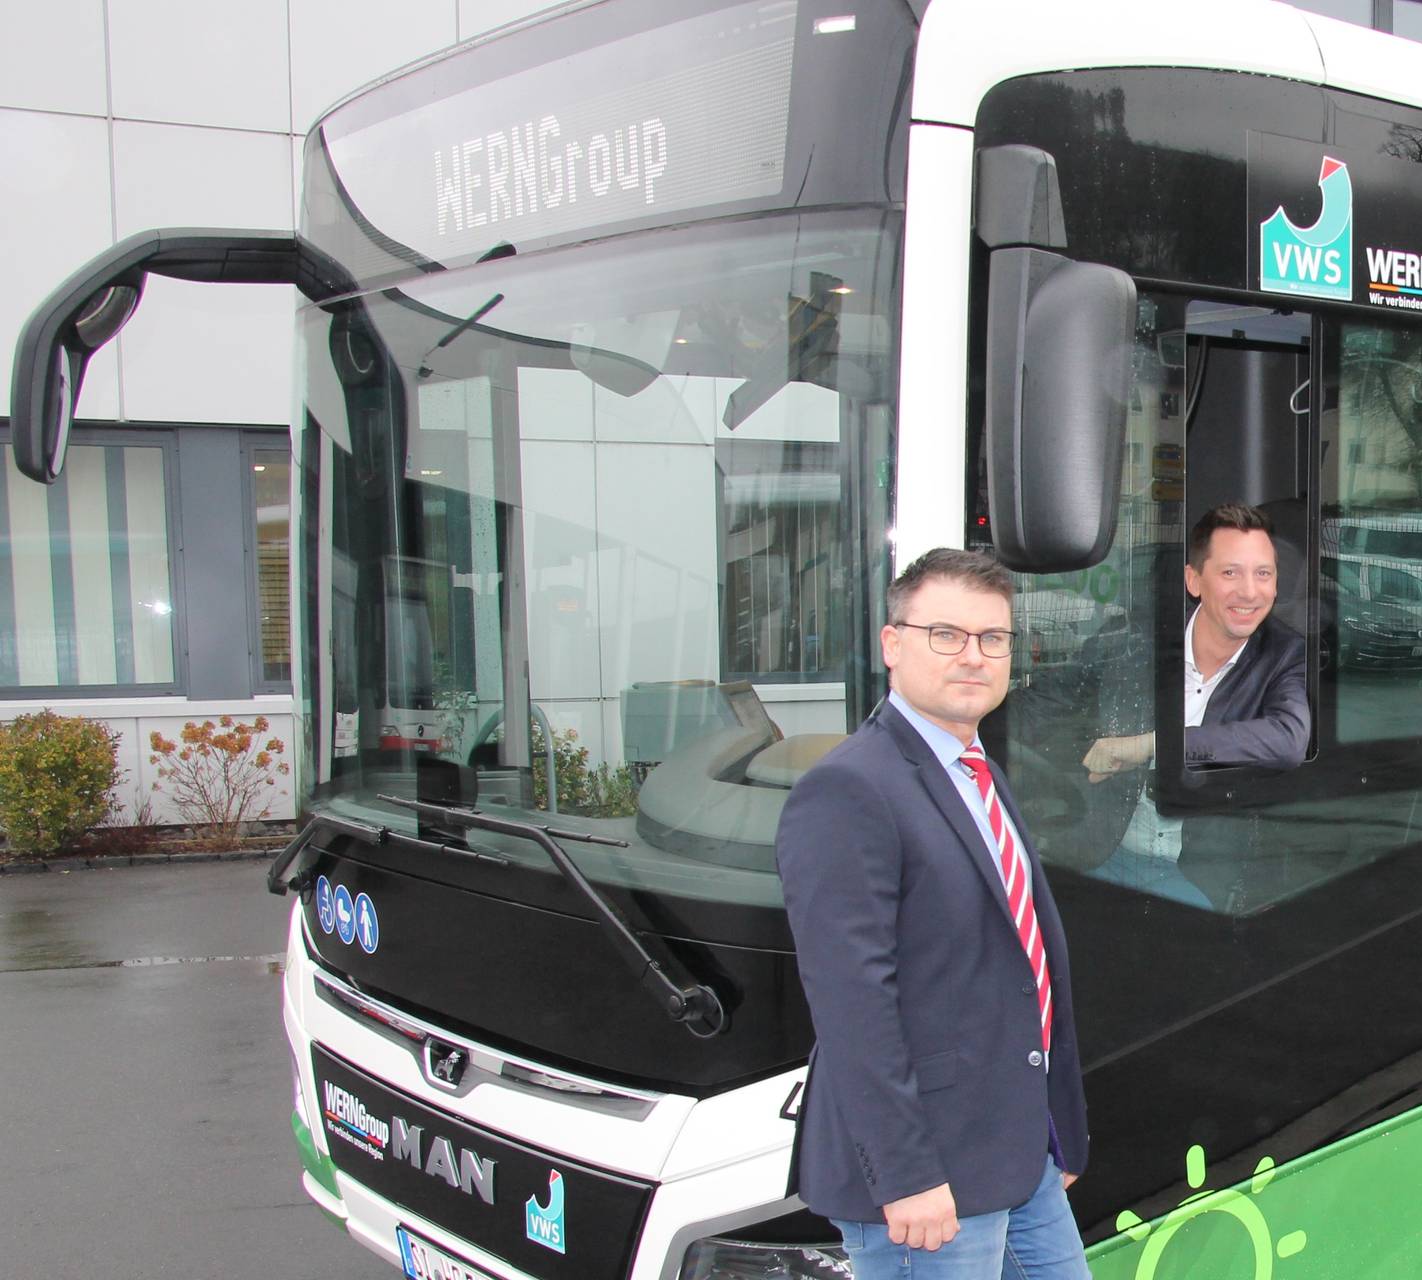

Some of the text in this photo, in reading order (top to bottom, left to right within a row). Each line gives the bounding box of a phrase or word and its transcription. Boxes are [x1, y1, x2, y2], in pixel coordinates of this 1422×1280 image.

[434, 114, 667, 236] WERNGroup
[1272, 240, 1342, 285] VWS
[1369, 292, 1384, 305] Wir
[324, 1079, 389, 1149] WERNGroup
[392, 1115, 498, 1206] MAN
[530, 1213, 560, 1244] VWS
